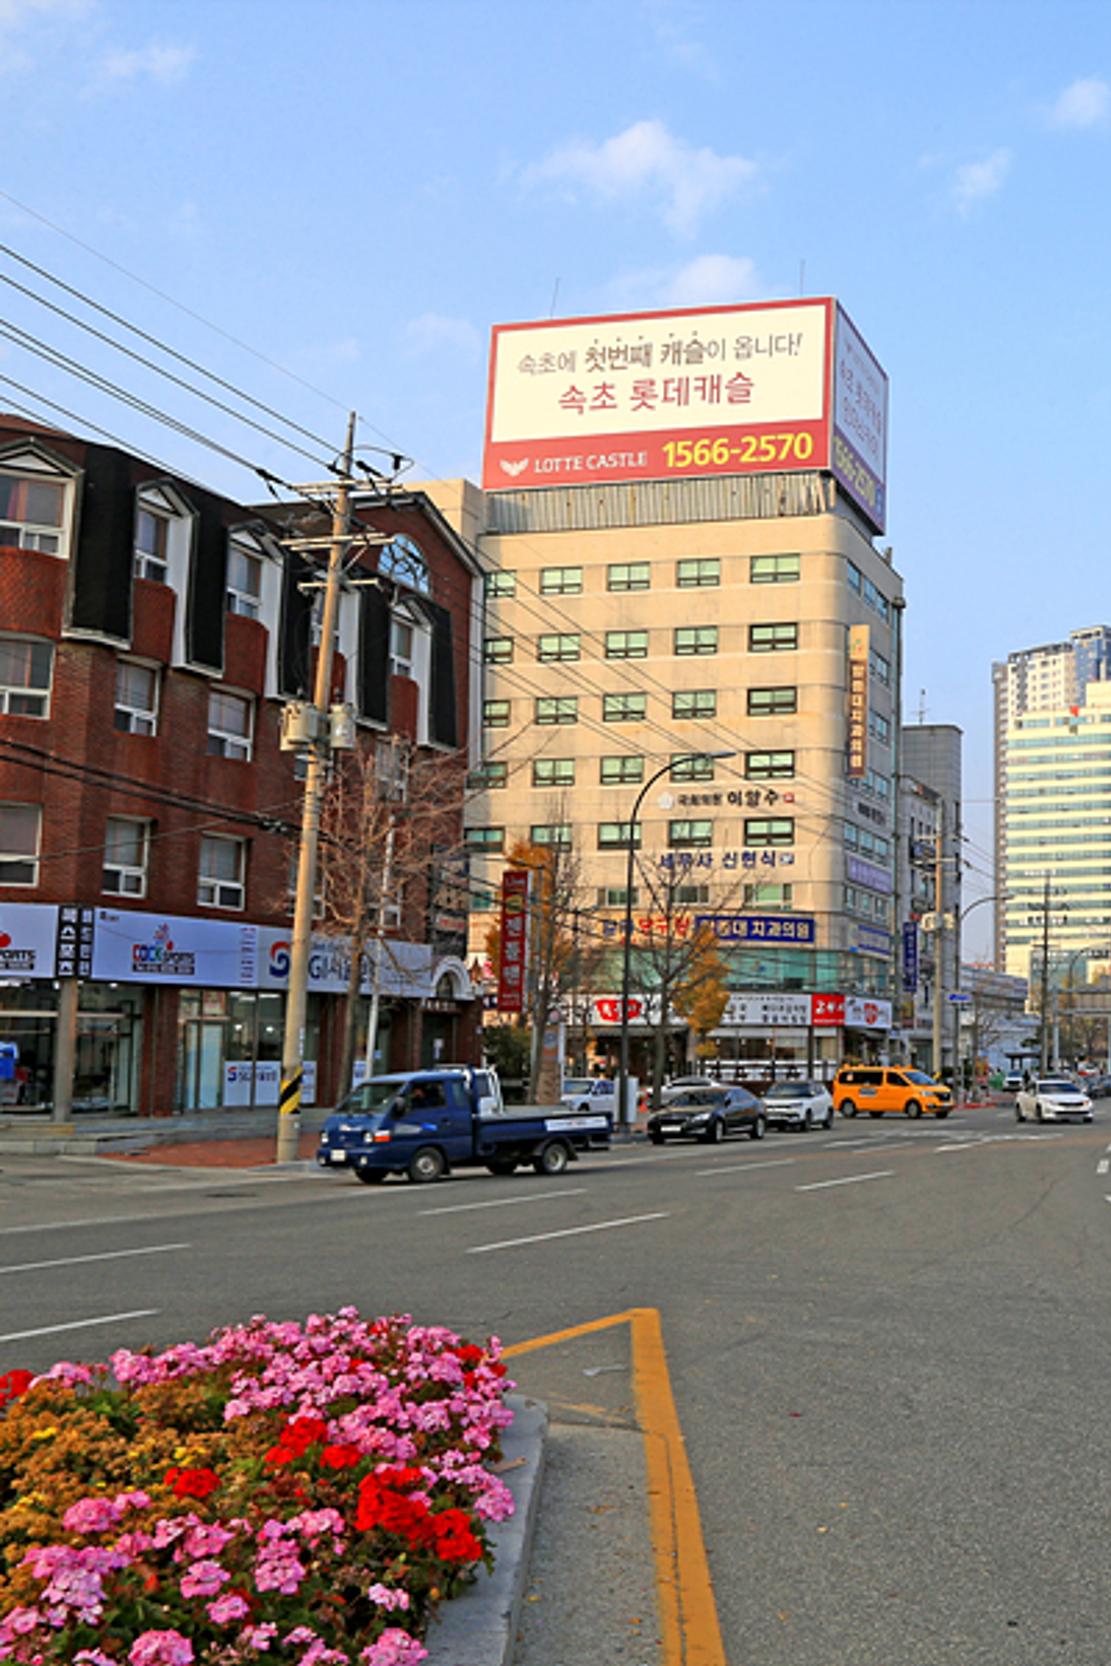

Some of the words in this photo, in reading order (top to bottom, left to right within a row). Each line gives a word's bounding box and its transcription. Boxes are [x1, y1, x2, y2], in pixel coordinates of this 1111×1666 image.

[516, 350, 577, 377] 속초에
[584, 343, 653, 374] 첫번째
[659, 336, 727, 367] 캐슬이
[733, 332, 803, 361] 옵니다!
[557, 383, 620, 416] 속초
[630, 370, 756, 413] 롯데캐슬
[662, 432, 814, 469] 1566-2570
[533, 455, 583, 475] LOTTE
[587, 450, 649, 471] CASTLE
[727, 788, 780, 807] 이양수
[660, 851, 714, 869] 세무사
[722, 850, 777, 869] 신현식
[752, 920, 809, 940] 치과의원
[132, 944, 162, 962] COCK
